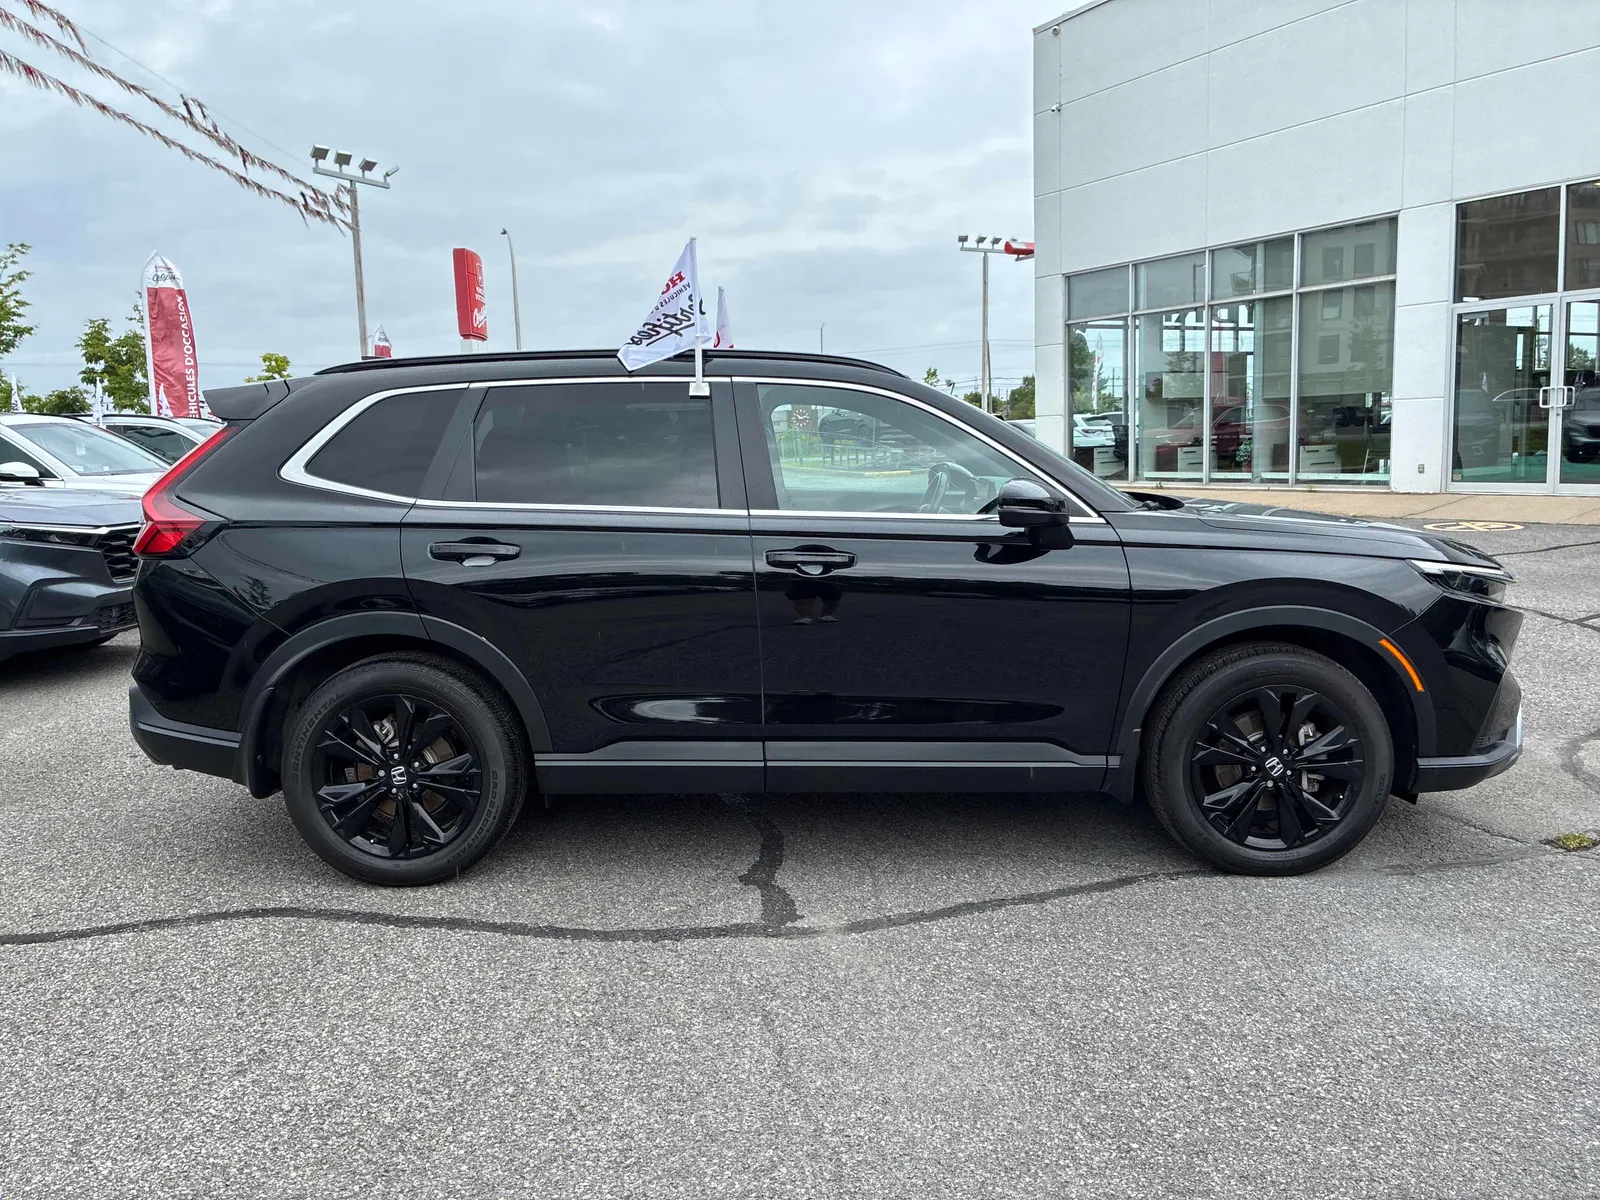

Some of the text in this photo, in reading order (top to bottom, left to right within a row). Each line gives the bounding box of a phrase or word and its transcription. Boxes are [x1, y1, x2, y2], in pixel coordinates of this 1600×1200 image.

[177, 294, 199, 419] ÉHICULES D'OCCASION
[292, 692, 345, 785] CONTINENTAL
[447, 771, 497, 864] CROSSCONTACT
